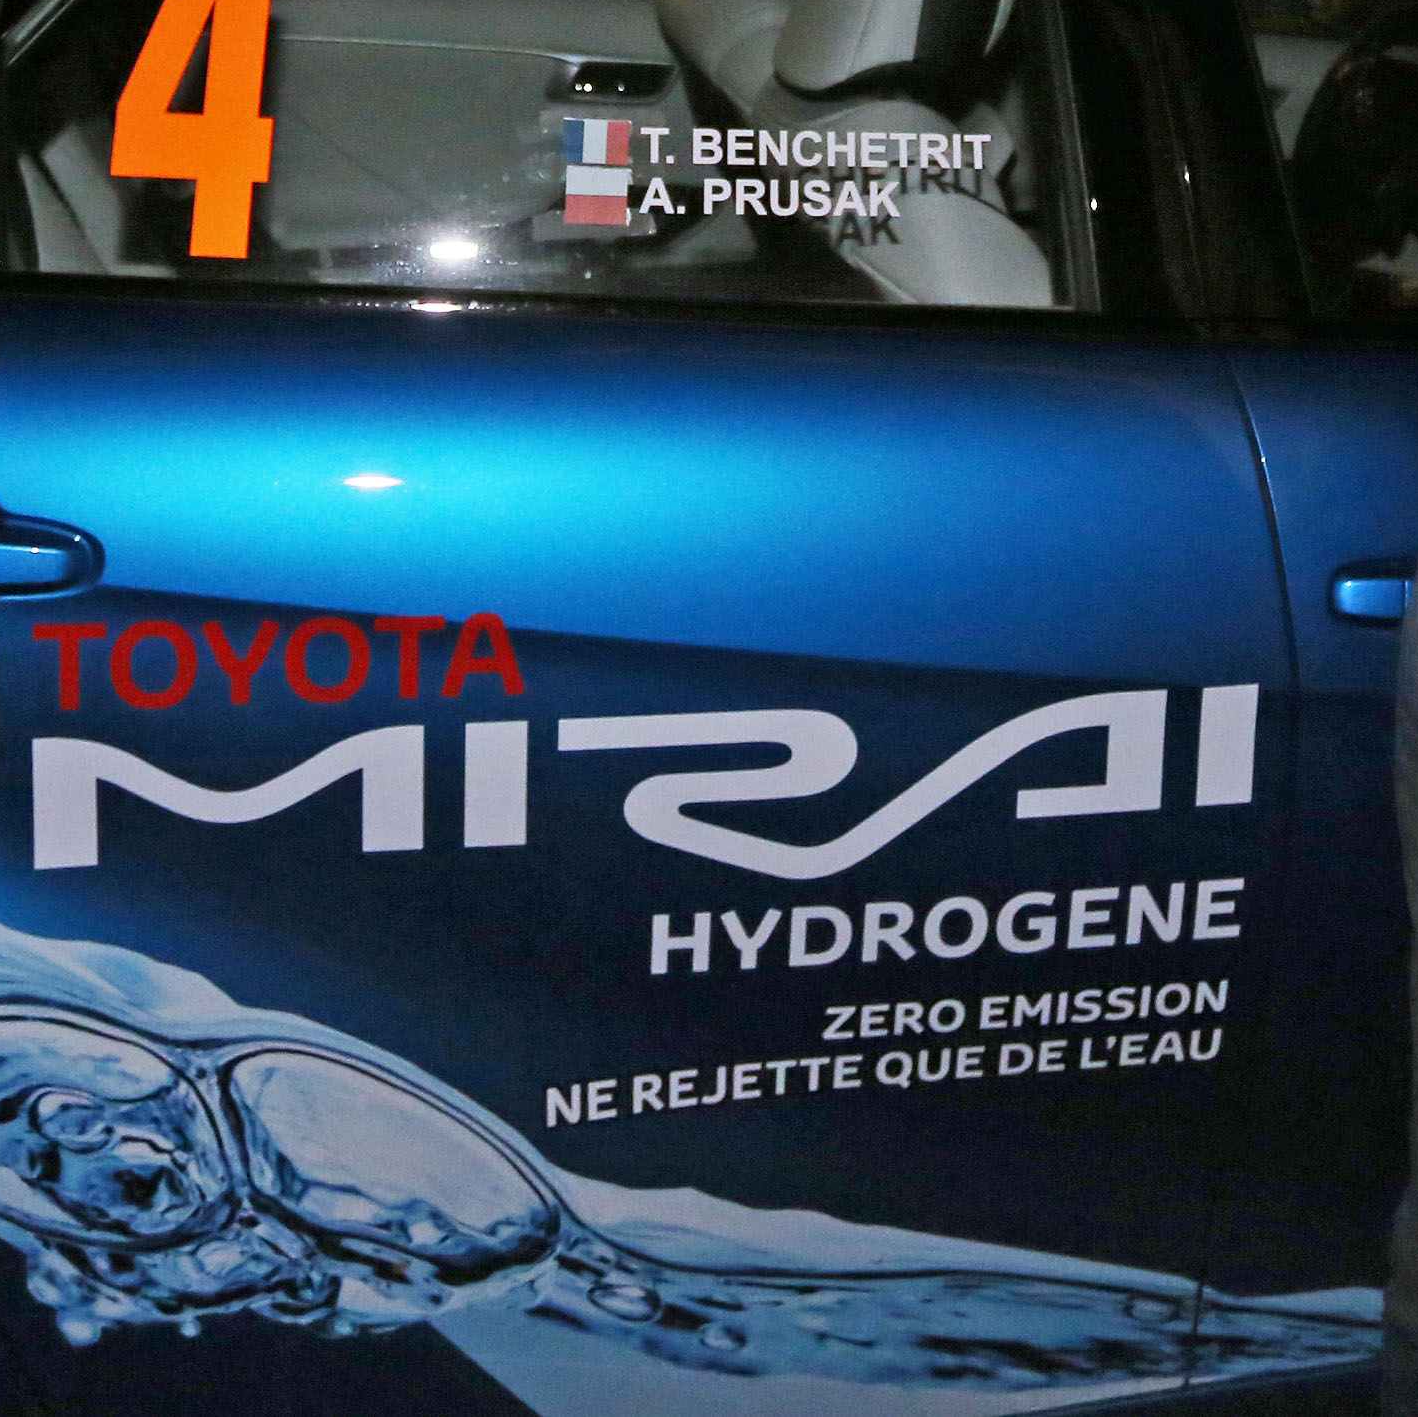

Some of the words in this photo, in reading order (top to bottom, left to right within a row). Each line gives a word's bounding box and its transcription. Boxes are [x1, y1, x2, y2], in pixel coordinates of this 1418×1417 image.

[638, 176, 686, 216] A.
[703, 177, 902, 219] PRUSAK
[639, 126, 676, 166] T.
[692, 127, 992, 171] BENCHETRIT
[33, 612, 525, 711] TOYOTA
[31, 683, 1260, 881] MIRAI
[649, 876, 1246, 975] HYDROGENE
[822, 998, 966, 1041] ZERO
[979, 980, 1229, 1029] EMISSION
[546, 1079, 619, 1129] NE
[632, 1056, 864, 1115] REJETTE
[875, 1045, 986, 1089] QUE
[998, 1038, 1068, 1076] DE
[1080, 1028, 1223, 1070] L'EAU
